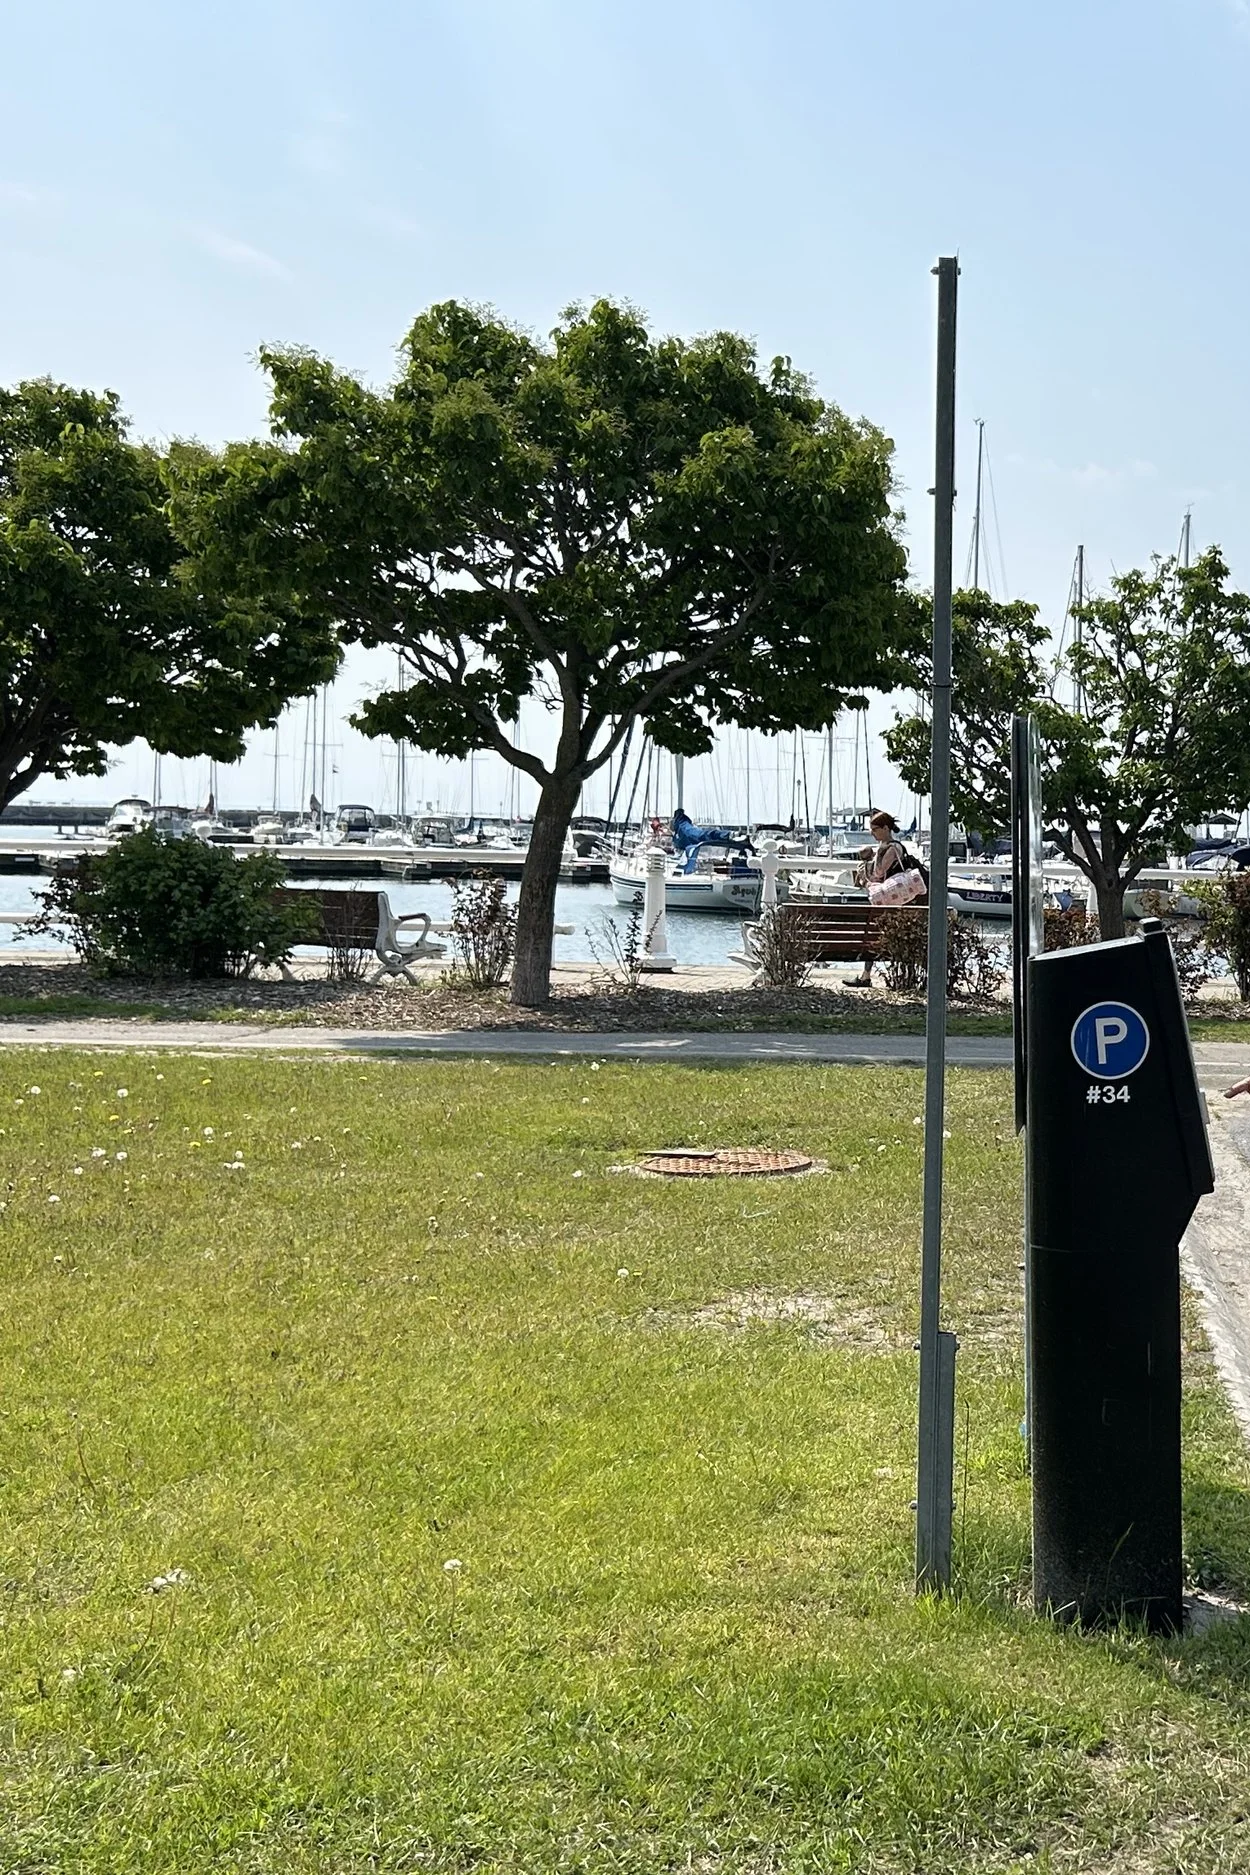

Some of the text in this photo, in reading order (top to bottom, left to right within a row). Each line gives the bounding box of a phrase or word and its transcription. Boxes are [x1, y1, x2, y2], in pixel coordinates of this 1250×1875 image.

[965, 891, 1004, 902] LIBERTY
[1095, 1017, 1127, 1064] P
[1086, 1085, 1131, 1104] #34
